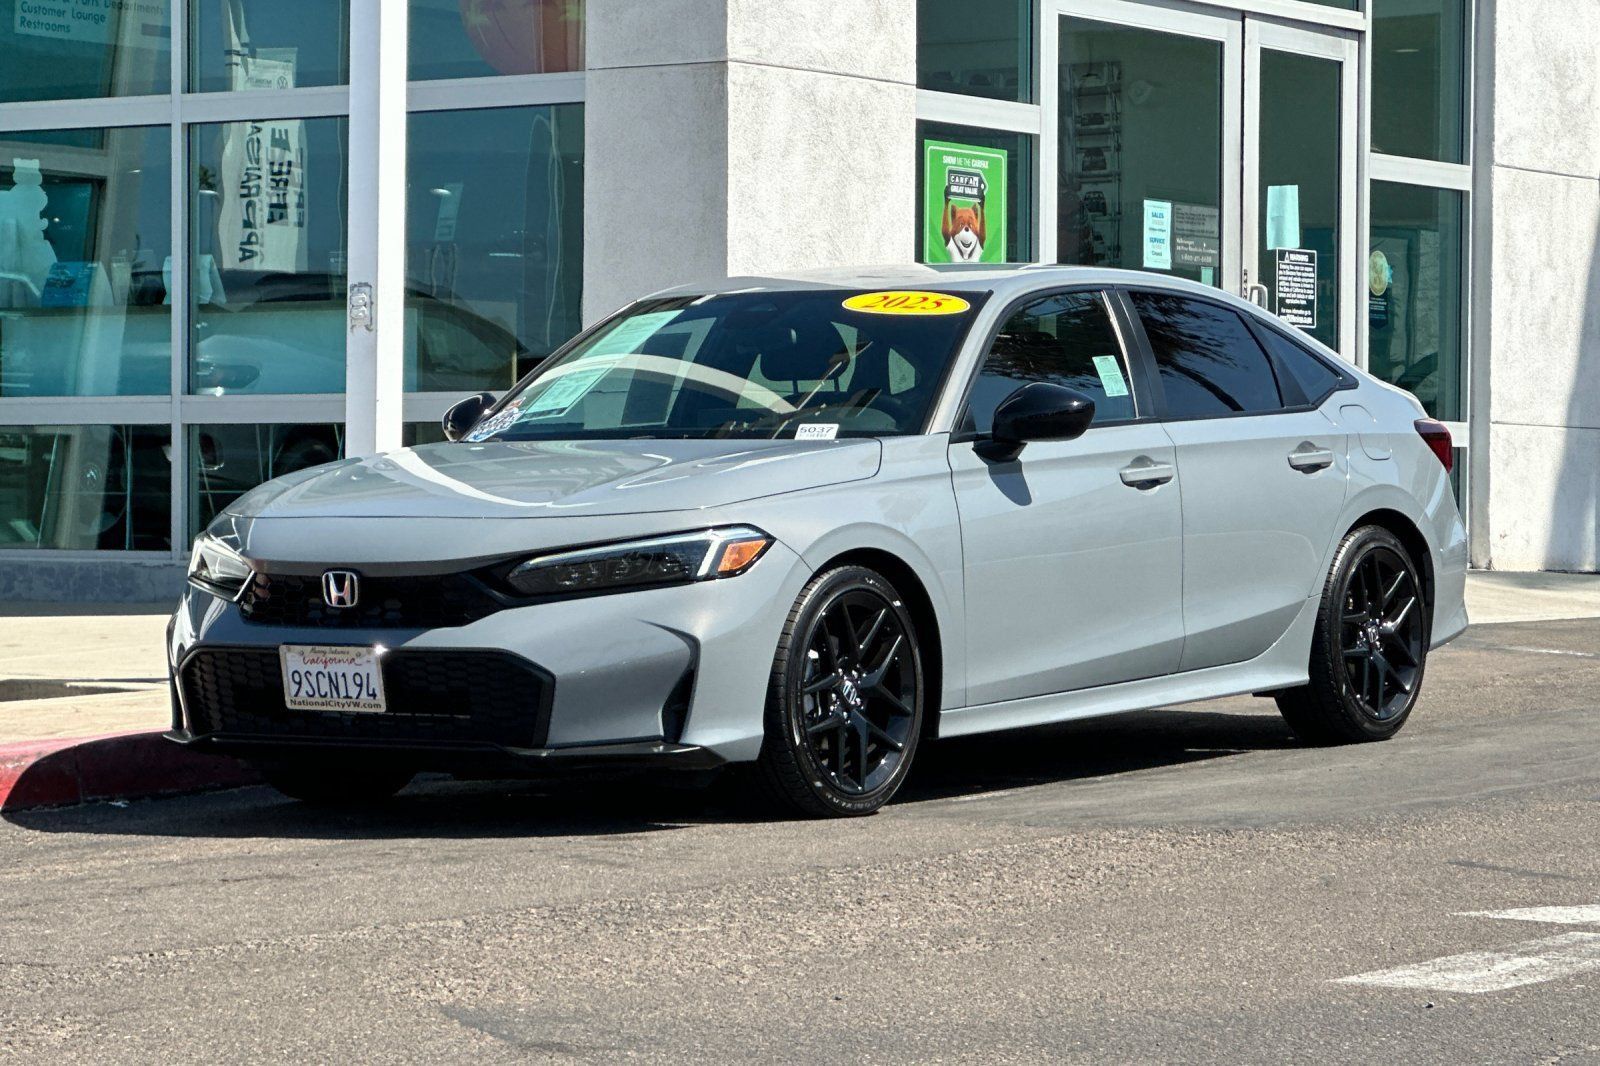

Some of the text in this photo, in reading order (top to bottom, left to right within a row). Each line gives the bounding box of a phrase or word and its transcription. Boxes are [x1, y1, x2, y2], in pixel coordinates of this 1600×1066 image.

[20, 2, 106, 24] Customer Lounge
[20, 16, 71, 33] Restrooms
[943, 156, 956, 164] SHOW
[1290, 253, 1309, 262] WARNING
[860, 295, 952, 310] 2025
[800, 426, 834, 434] 5037
[302, 656, 361, 669] California
[291, 669, 378, 699] 9SCN194
[290, 699, 382, 710] NationalCityVW.com
